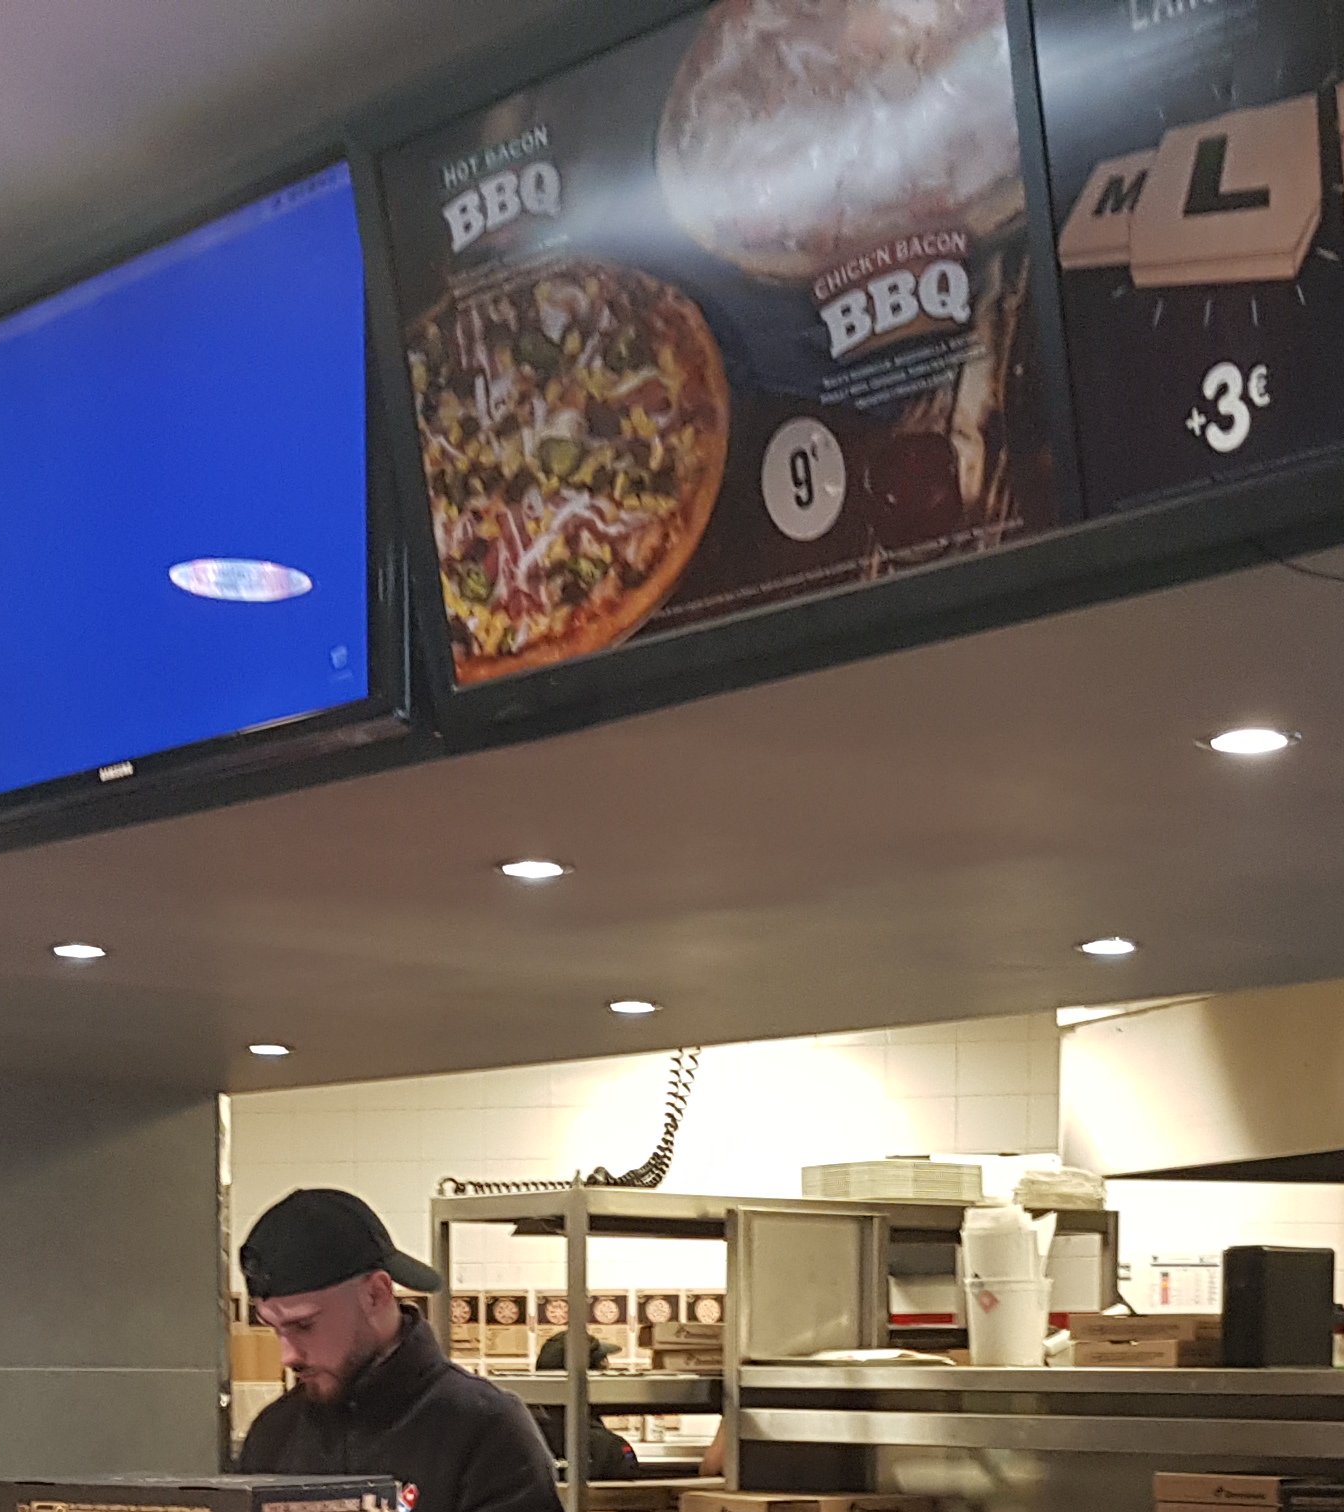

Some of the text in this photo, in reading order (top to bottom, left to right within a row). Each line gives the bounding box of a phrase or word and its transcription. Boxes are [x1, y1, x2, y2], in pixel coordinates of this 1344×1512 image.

[442, 125, 549, 189] HOT BACON
[1091, 169, 1149, 219] M
[1182, 134, 1271, 219] L
[442, 161, 562, 253] BBQ
[814, 231, 967, 300] CHICK'N BACON
[819, 259, 972, 360] BBQ
